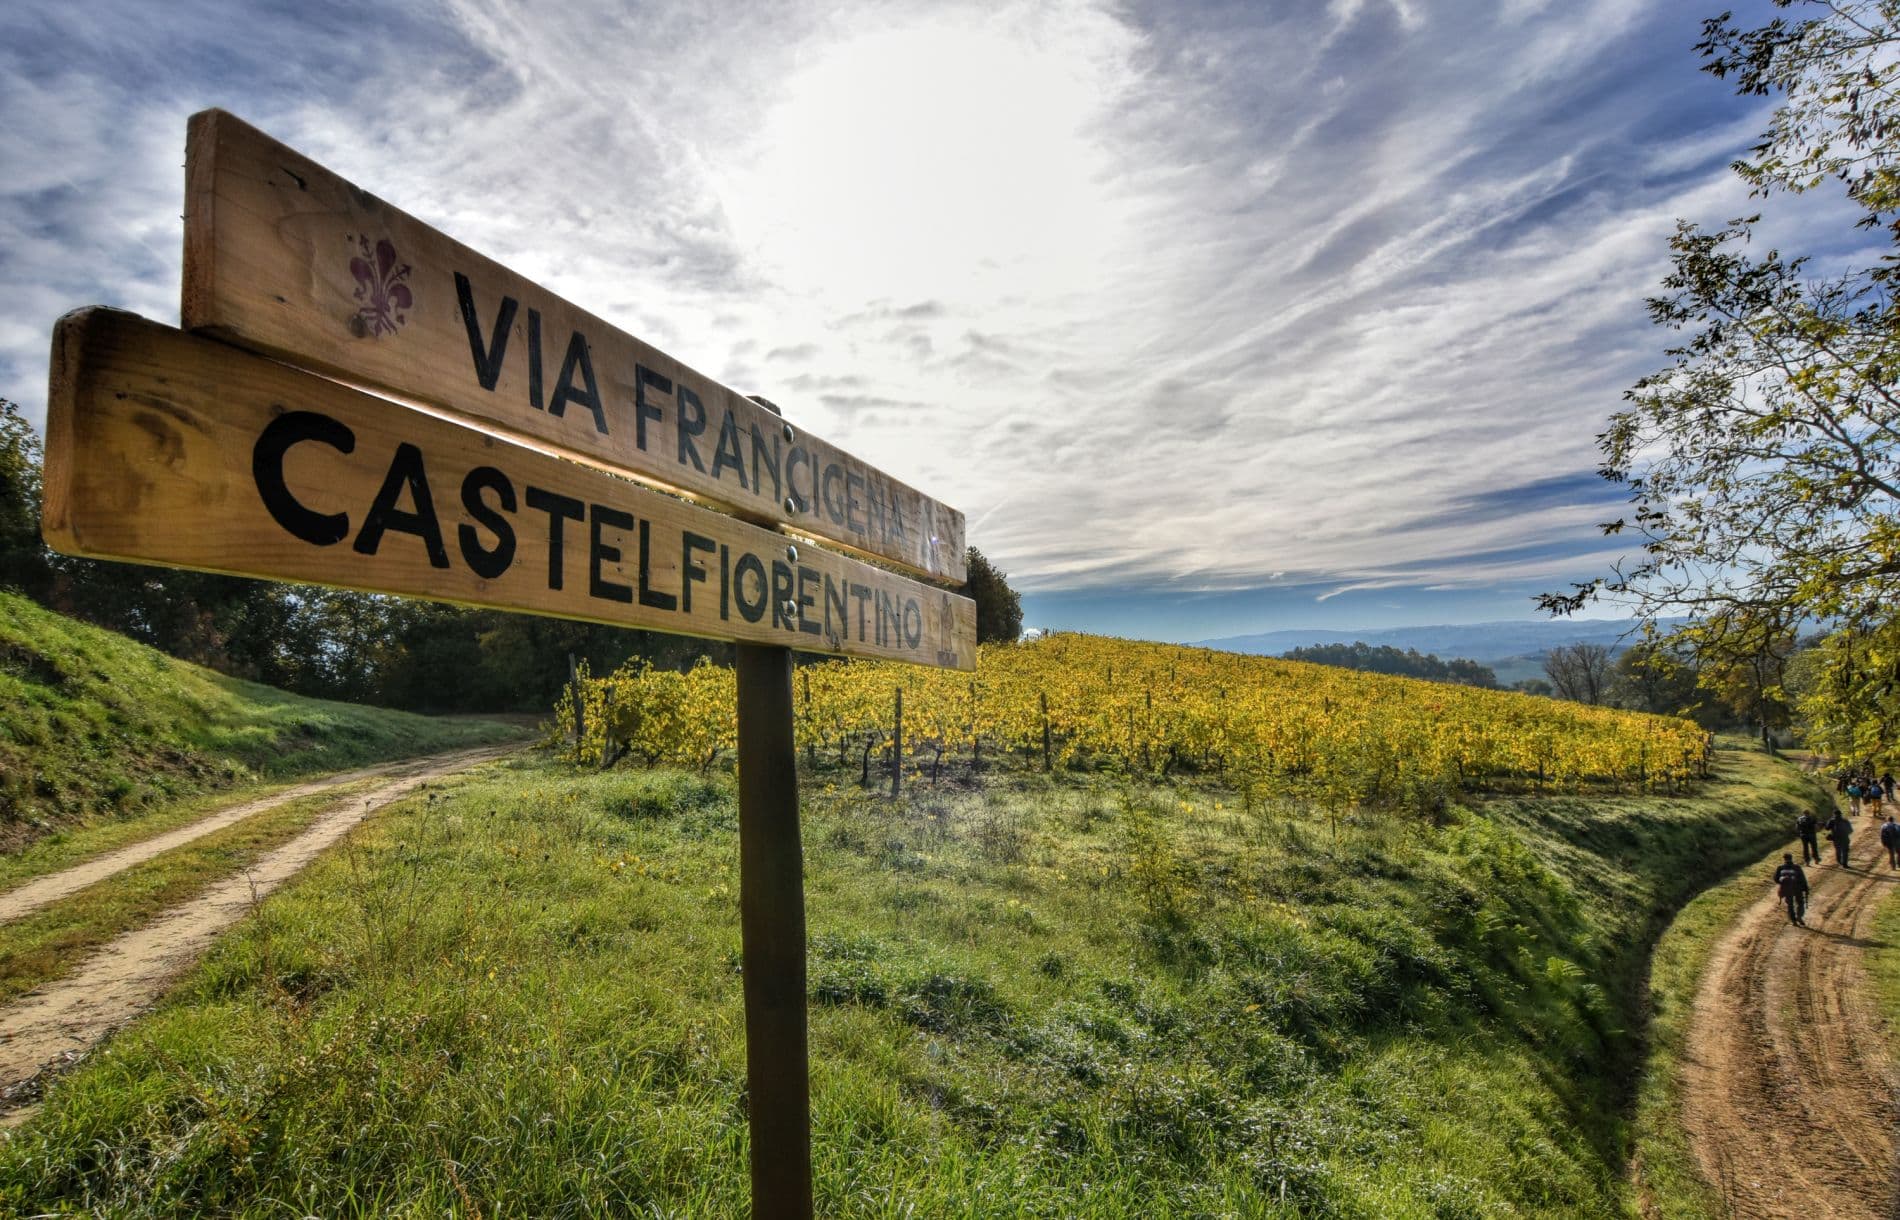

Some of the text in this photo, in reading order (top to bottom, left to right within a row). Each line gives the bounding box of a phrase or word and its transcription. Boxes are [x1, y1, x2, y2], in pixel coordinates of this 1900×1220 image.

[252, 410, 922, 651] CASTELFIORENTINO
[453, 271, 904, 547] VIA FRANCIGENA
